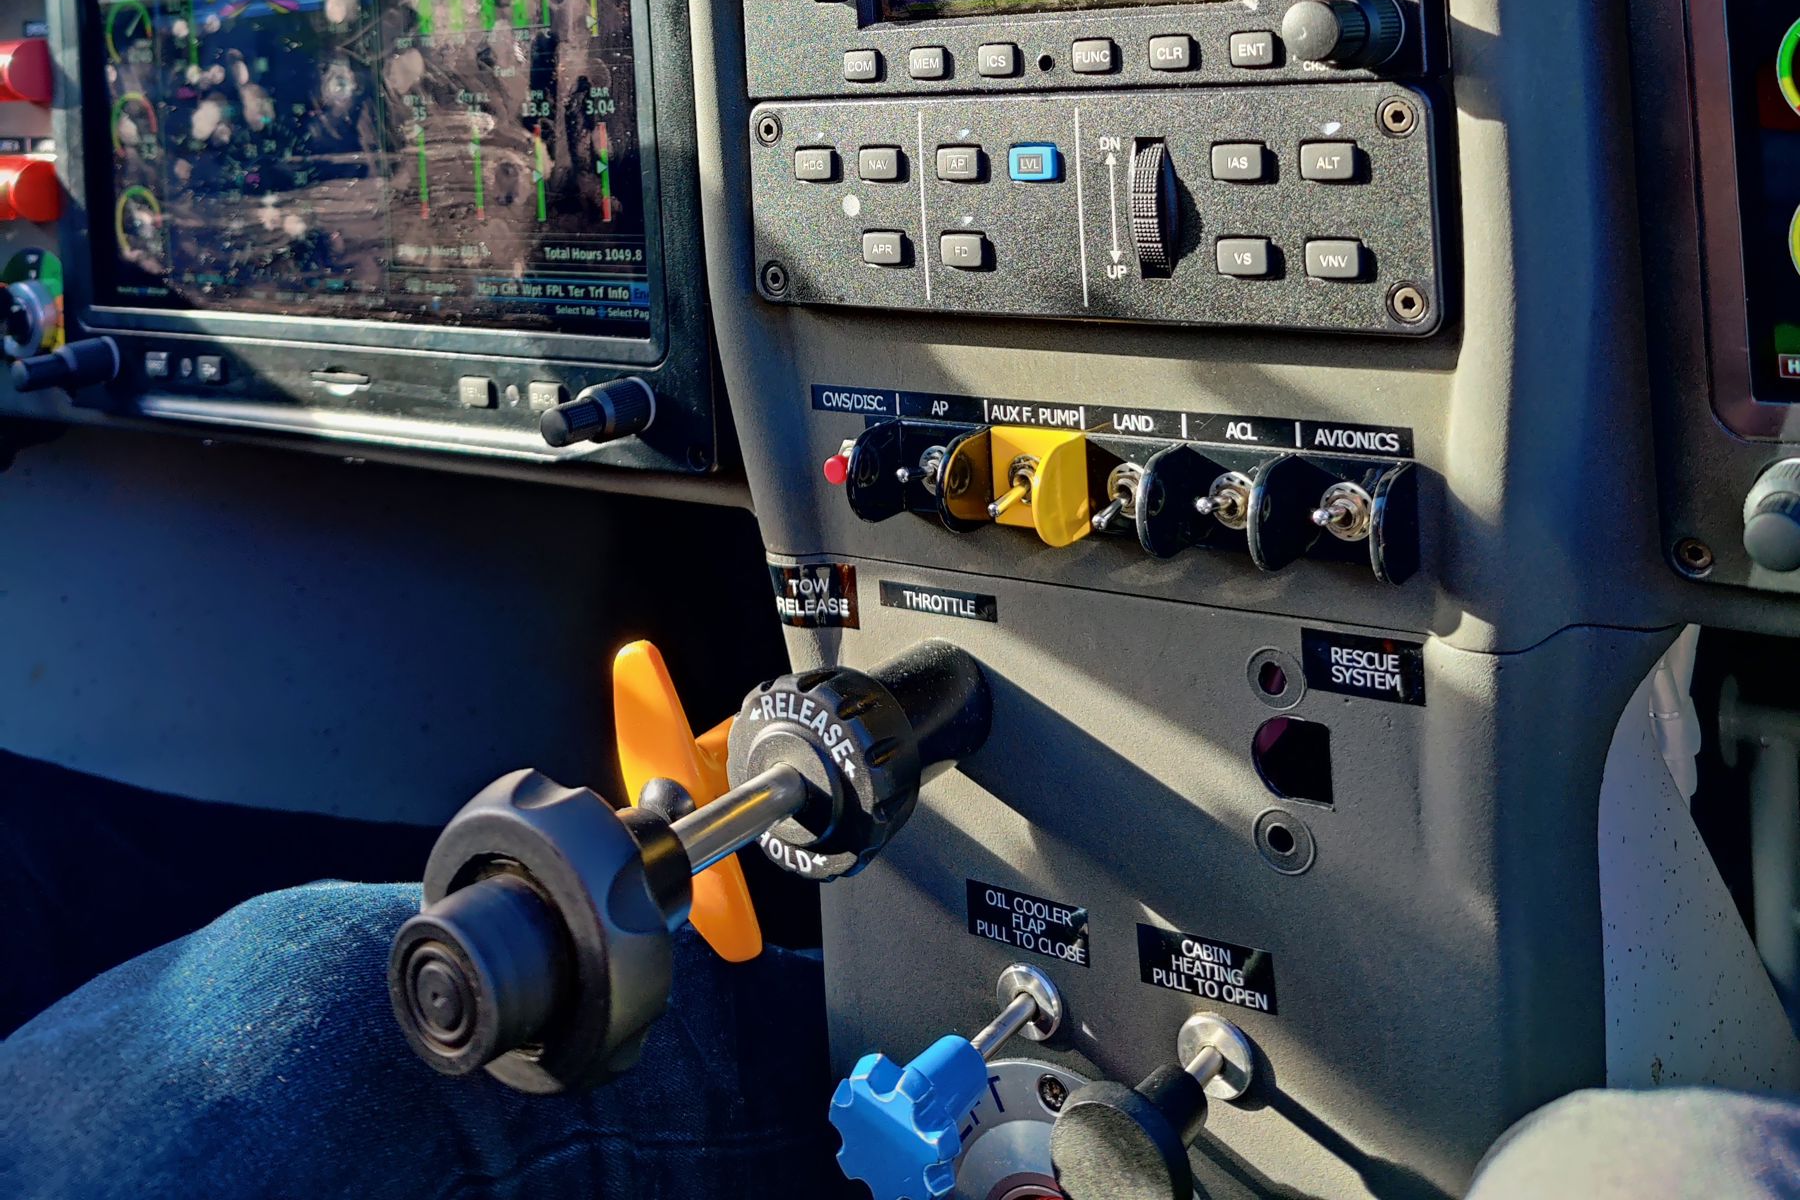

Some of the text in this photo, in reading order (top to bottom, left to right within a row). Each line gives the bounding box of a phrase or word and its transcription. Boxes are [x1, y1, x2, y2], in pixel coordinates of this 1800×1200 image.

[1075, 51, 1109, 62] FUNC
[1157, 47, 1182, 59] CLR
[1238, 44, 1264, 56] ENT
[848, 61, 872, 72] COM
[913, 58, 939, 68] MEM
[986, 56, 1005, 66] ICS
[590, 87, 610, 98] BAR
[586, 99, 616, 115] 3.04
[1100, 137, 1120, 150] DN
[802, 159, 823, 170] HDG
[869, 159, 888, 170] NAV
[951, 159, 964, 168] AP
[1020, 159, 1039, 169] LVL
[1227, 157, 1248, 169] IAS
[1316, 157, 1340, 169] ALT
[544, 247, 642, 262] Total Hours 1049.8
[872, 245, 892, 255] APR
[955, 246, 968, 256] FD
[1234, 253, 1251, 265] VS
[1319, 256, 1347, 267] VNV
[1107, 265, 1126, 278] UP
[823, 391, 887, 411] CWS/DISC.
[932, 401, 948, 416] AP
[991, 405, 1078, 426] AUX F. PUMP
[1113, 413, 1154, 432] LAND
[1226, 422, 1257, 440] ACL
[1314, 428, 1399, 451] AVIONICS
[789, 579, 830, 596] TOW
[776, 596, 849, 617] RELEASE
[903, 590, 975, 616] THROTTLE
[1331, 648, 1399, 672] RESCUE
[1332, 666, 1400, 691] SYSTEM
[760, 693, 855, 763] RELEASE
[986, 890, 1072, 926] OIL COOLER
[1012, 913, 1045, 934] FLAP
[977, 920, 1085, 964] PULL TO CLOSE
[1182, 939, 1230, 965] CABIN
[1171, 955, 1243, 987] HEATING
[1153, 968, 1268, 1011] PULL TO OPEN
